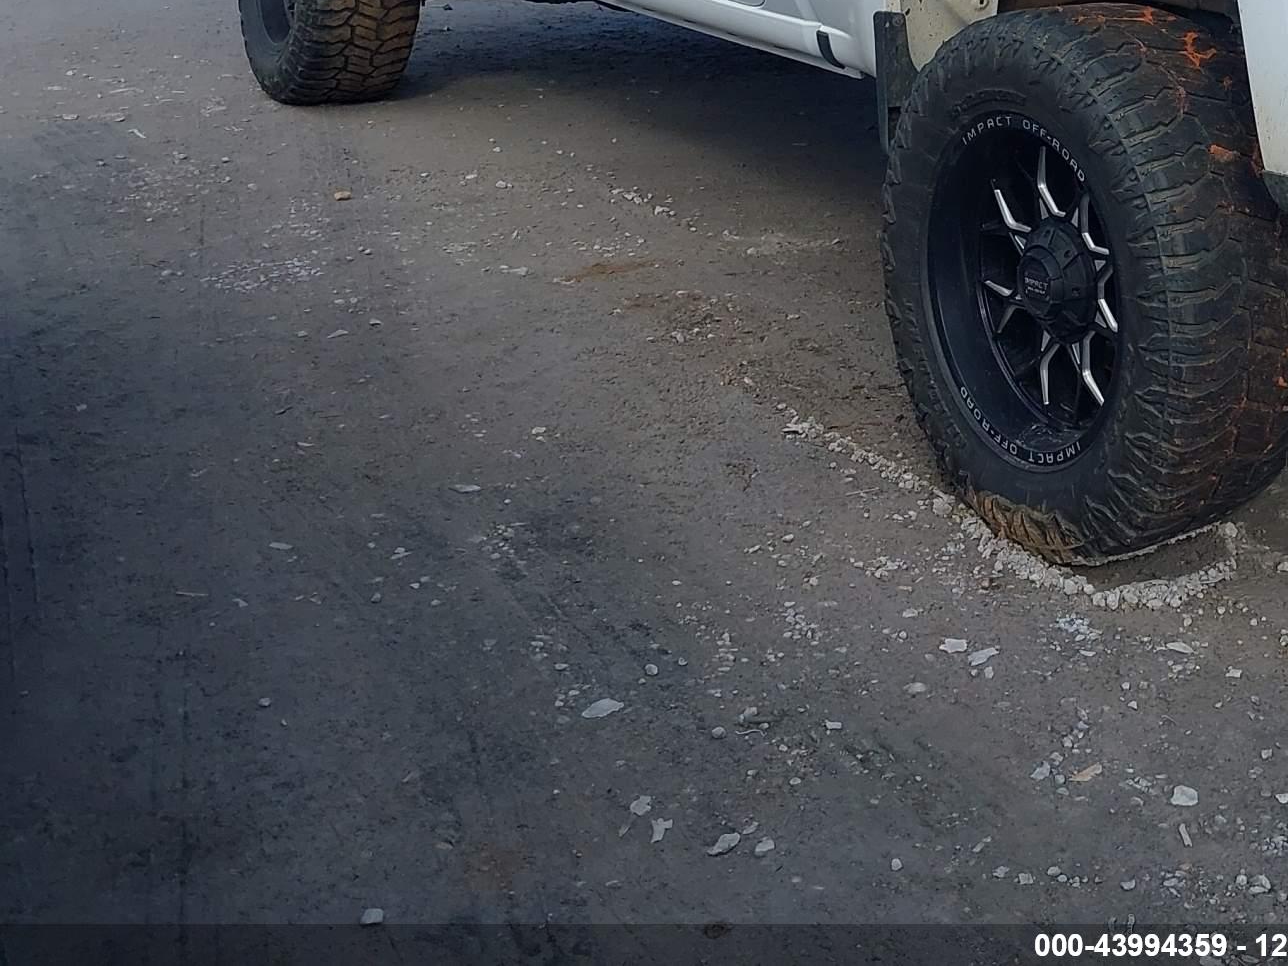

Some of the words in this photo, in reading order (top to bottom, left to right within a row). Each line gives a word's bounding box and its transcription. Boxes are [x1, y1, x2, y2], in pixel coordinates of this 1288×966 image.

[962, 115, 1013, 146] IMPACT
[1022, 119, 1086, 182] OFF-ROAD
[1027, 441, 1082, 465] IMPACT
